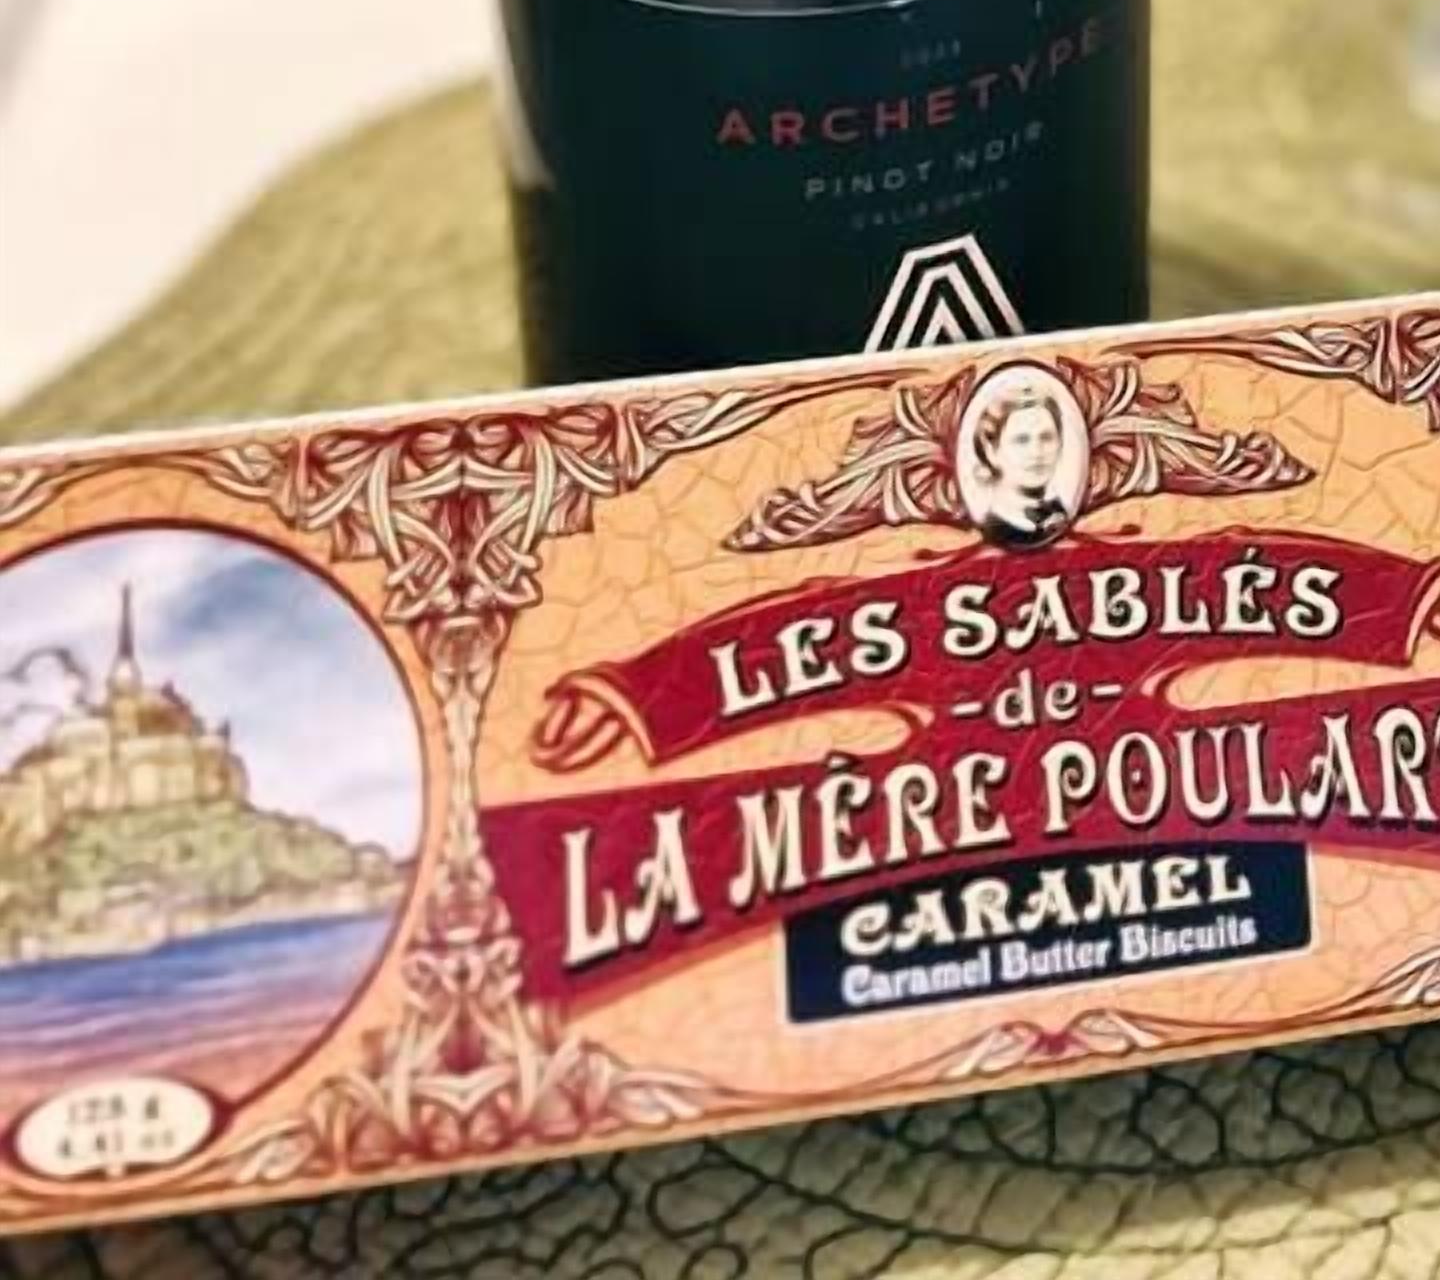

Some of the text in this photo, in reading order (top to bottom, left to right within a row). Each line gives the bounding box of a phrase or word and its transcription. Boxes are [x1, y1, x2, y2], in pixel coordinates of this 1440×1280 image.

[715, 17, 1100, 147] ARCHETYPE
[805, 121, 1044, 201] PINOT NOIR
[710, 546, 1341, 717] LES SABLÉS
[562, 809, 702, 968] LA
[840, 856, 1252, 956] CARAMEL
[841, 914, 1258, 1007] Caramel Butter Biscuits
